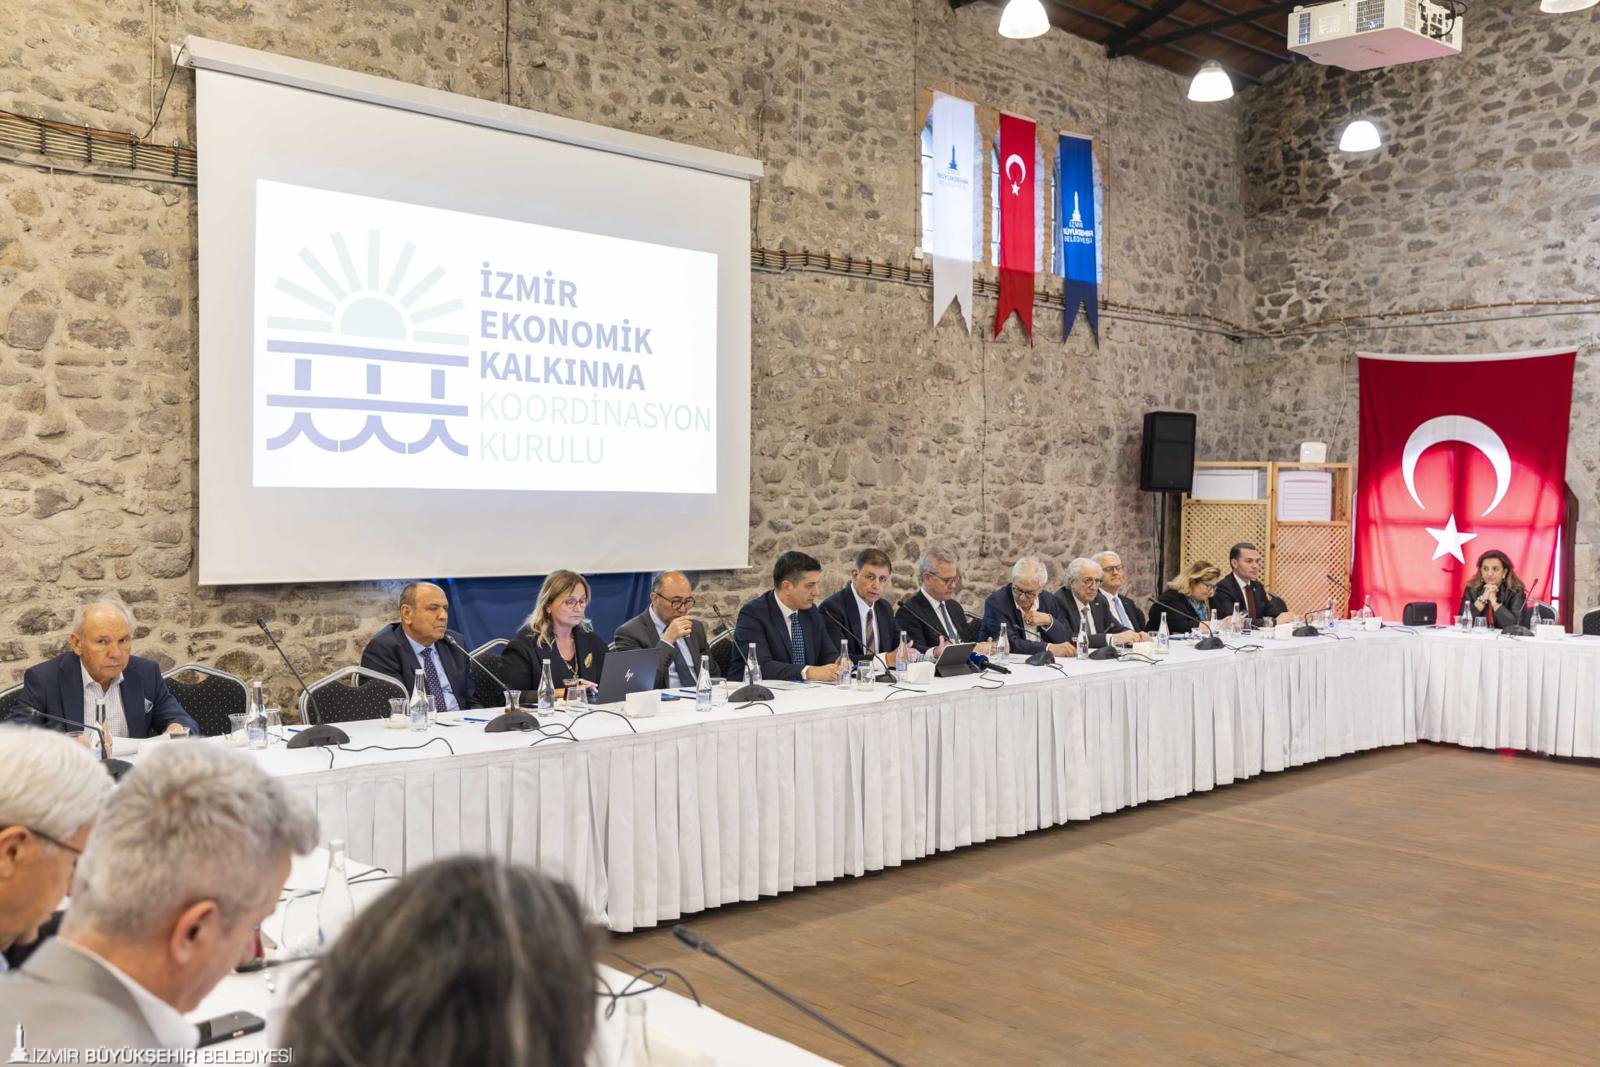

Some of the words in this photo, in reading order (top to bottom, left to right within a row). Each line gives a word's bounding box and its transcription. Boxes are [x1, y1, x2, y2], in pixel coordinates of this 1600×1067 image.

[480, 261, 578, 309] İZMİR
[480, 310, 653, 354] EKONOMİK
[480, 350, 646, 391] KALKINMA
[479, 392, 711, 433] KOORDİNASYON
[479, 432, 605, 464] KURULU
